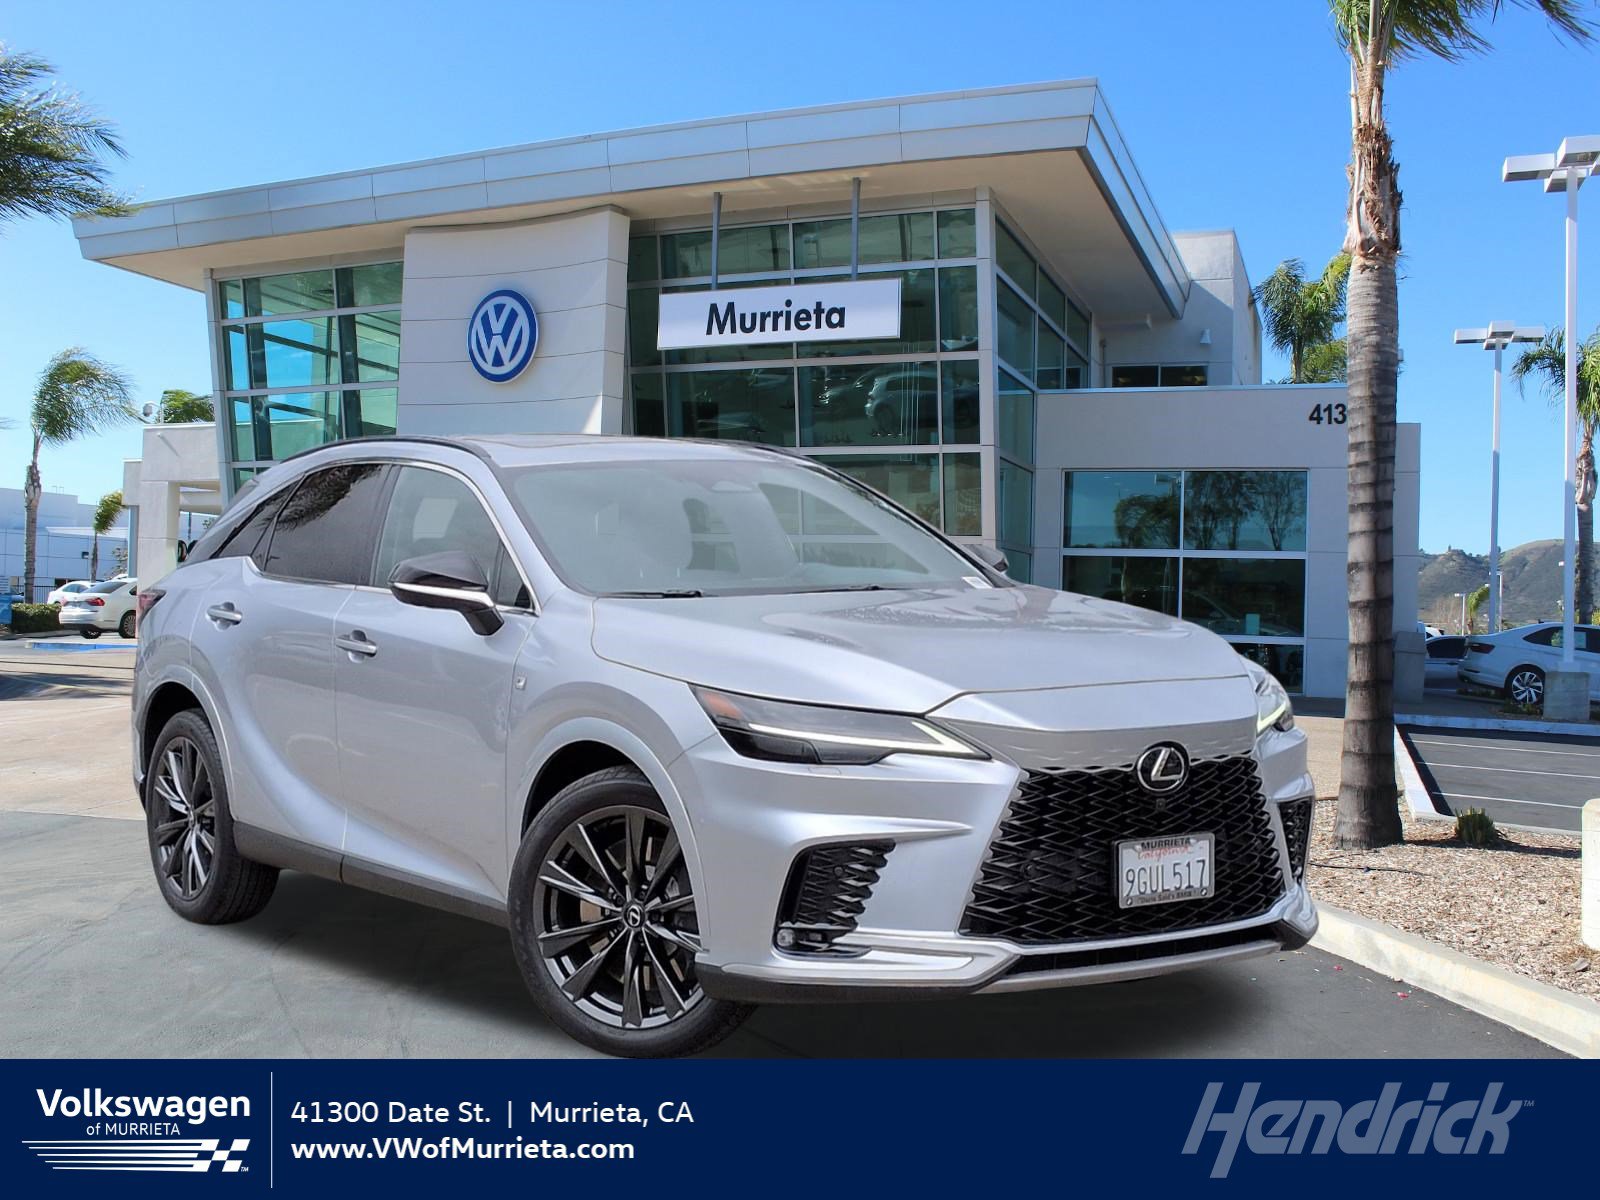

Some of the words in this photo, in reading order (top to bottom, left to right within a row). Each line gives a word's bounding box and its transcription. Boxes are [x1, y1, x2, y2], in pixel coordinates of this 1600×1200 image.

[706, 299, 846, 336] Murrieta
[1140, 837, 1191, 850] MURRIETA
[1125, 859, 1206, 897] 9GUL517
